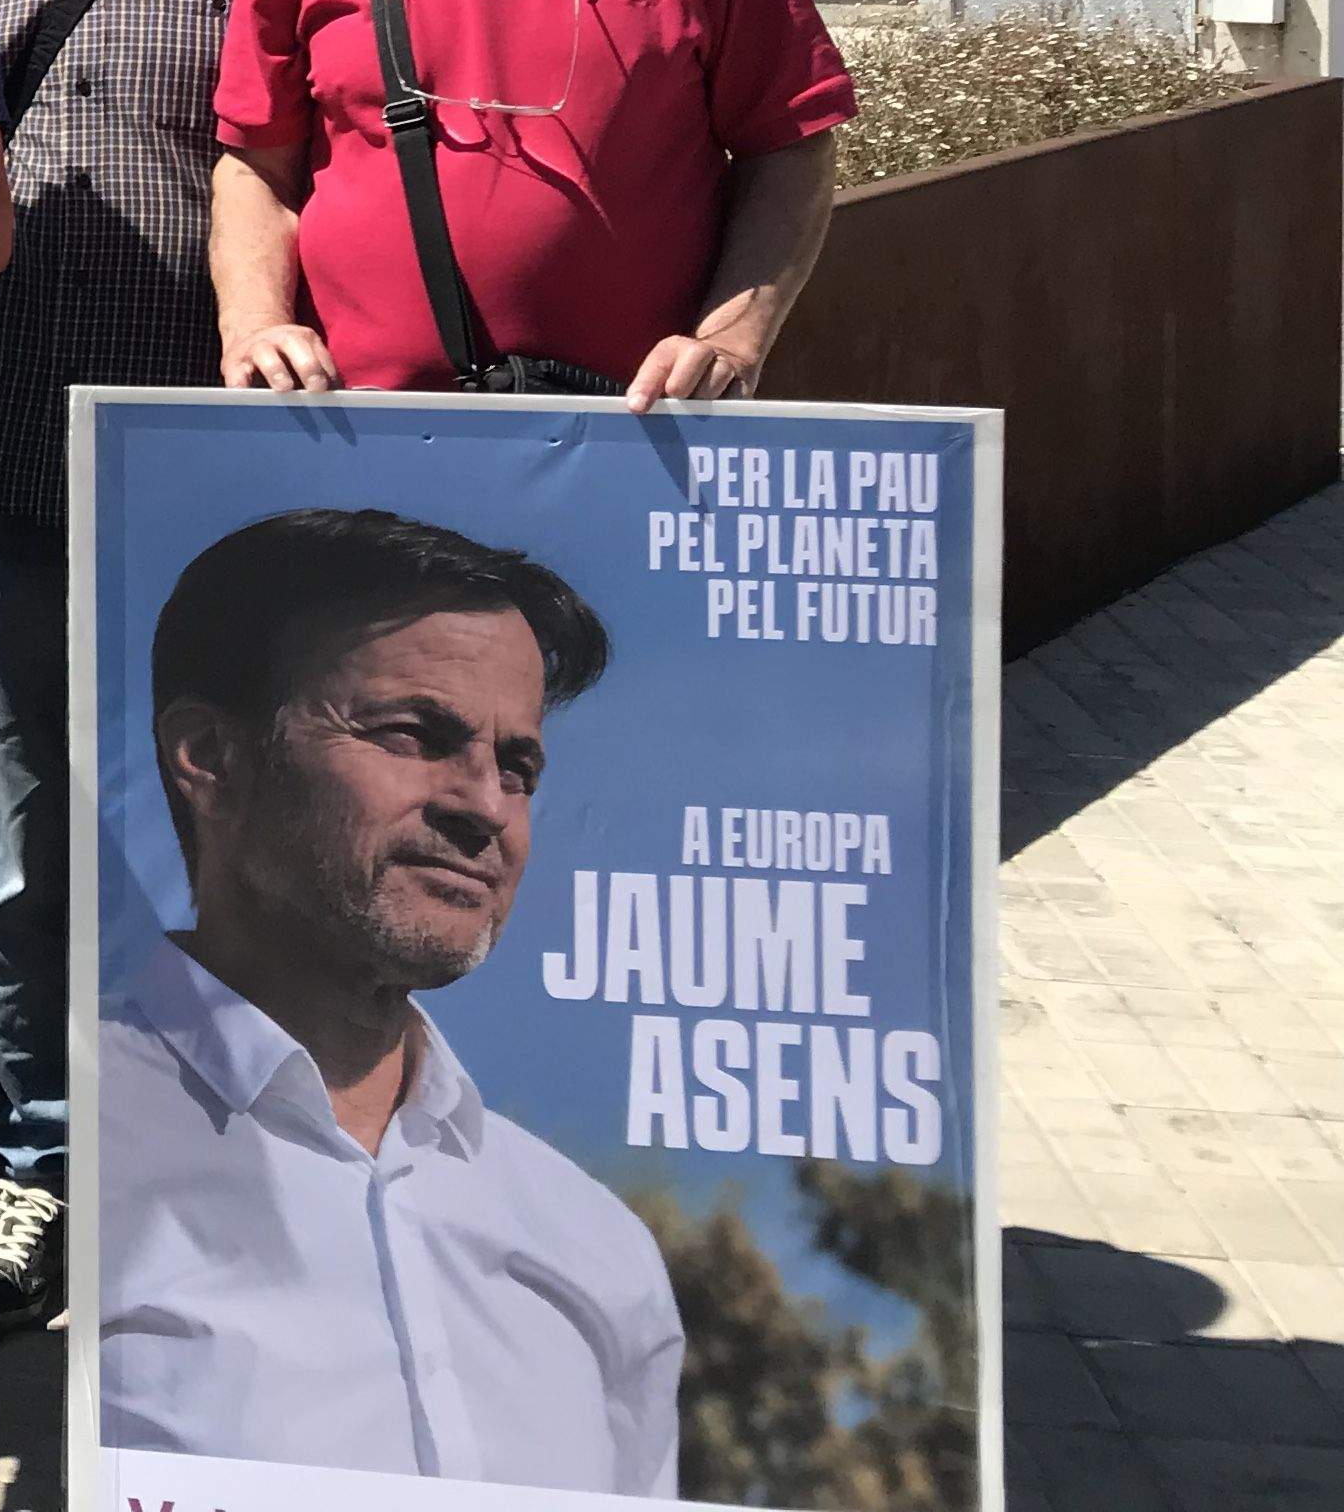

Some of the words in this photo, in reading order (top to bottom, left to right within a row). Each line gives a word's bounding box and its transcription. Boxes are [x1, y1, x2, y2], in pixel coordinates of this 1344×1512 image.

[687, 446, 771, 508] PER
[782, 448, 837, 510] LA
[849, 451, 938, 513] PAU
[648, 510, 725, 573] PEL
[737, 513, 938, 580] PLANETA
[707, 578, 785, 641] PEL
[796, 581, 937, 646] FUTUR
[681, 805, 711, 866] A
[721, 807, 892, 875] EUROPA
[542, 870, 871, 1017] JAUME
[626, 1014, 942, 1166] ASENS
